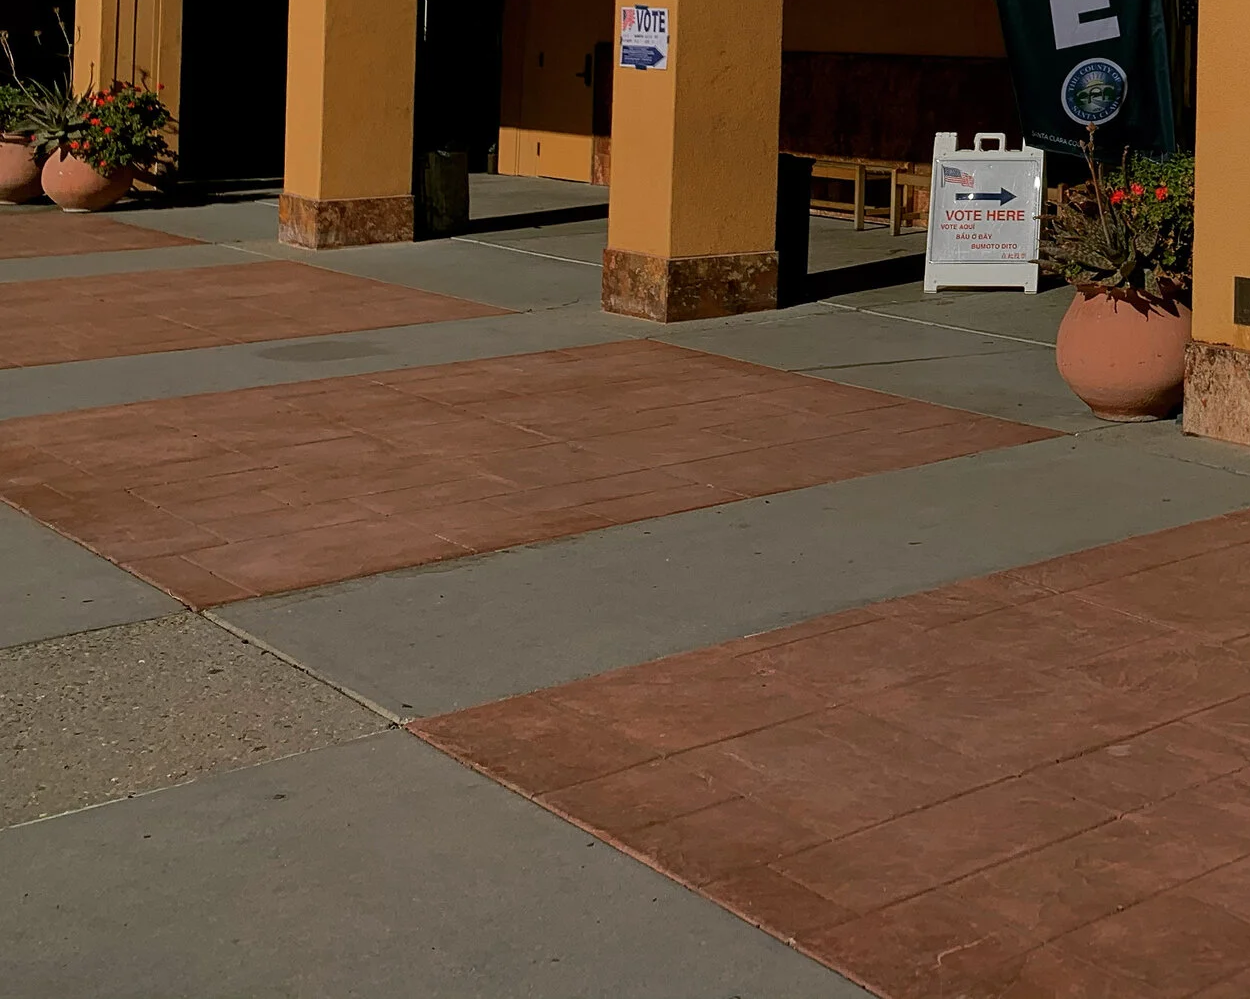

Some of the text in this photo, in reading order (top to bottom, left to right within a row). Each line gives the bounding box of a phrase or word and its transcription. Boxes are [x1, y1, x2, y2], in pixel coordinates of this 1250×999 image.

[636, 9, 666, 33] VOTE
[1068, 64, 1122, 91] THE COUNTY OF
[1073, 96, 1121, 120] SANTA CLARA
[1031, 130, 1048, 140] SANTA
[1048, 134, 1068, 145] CLARA
[945, 210, 1025, 221] VOTE HERE
